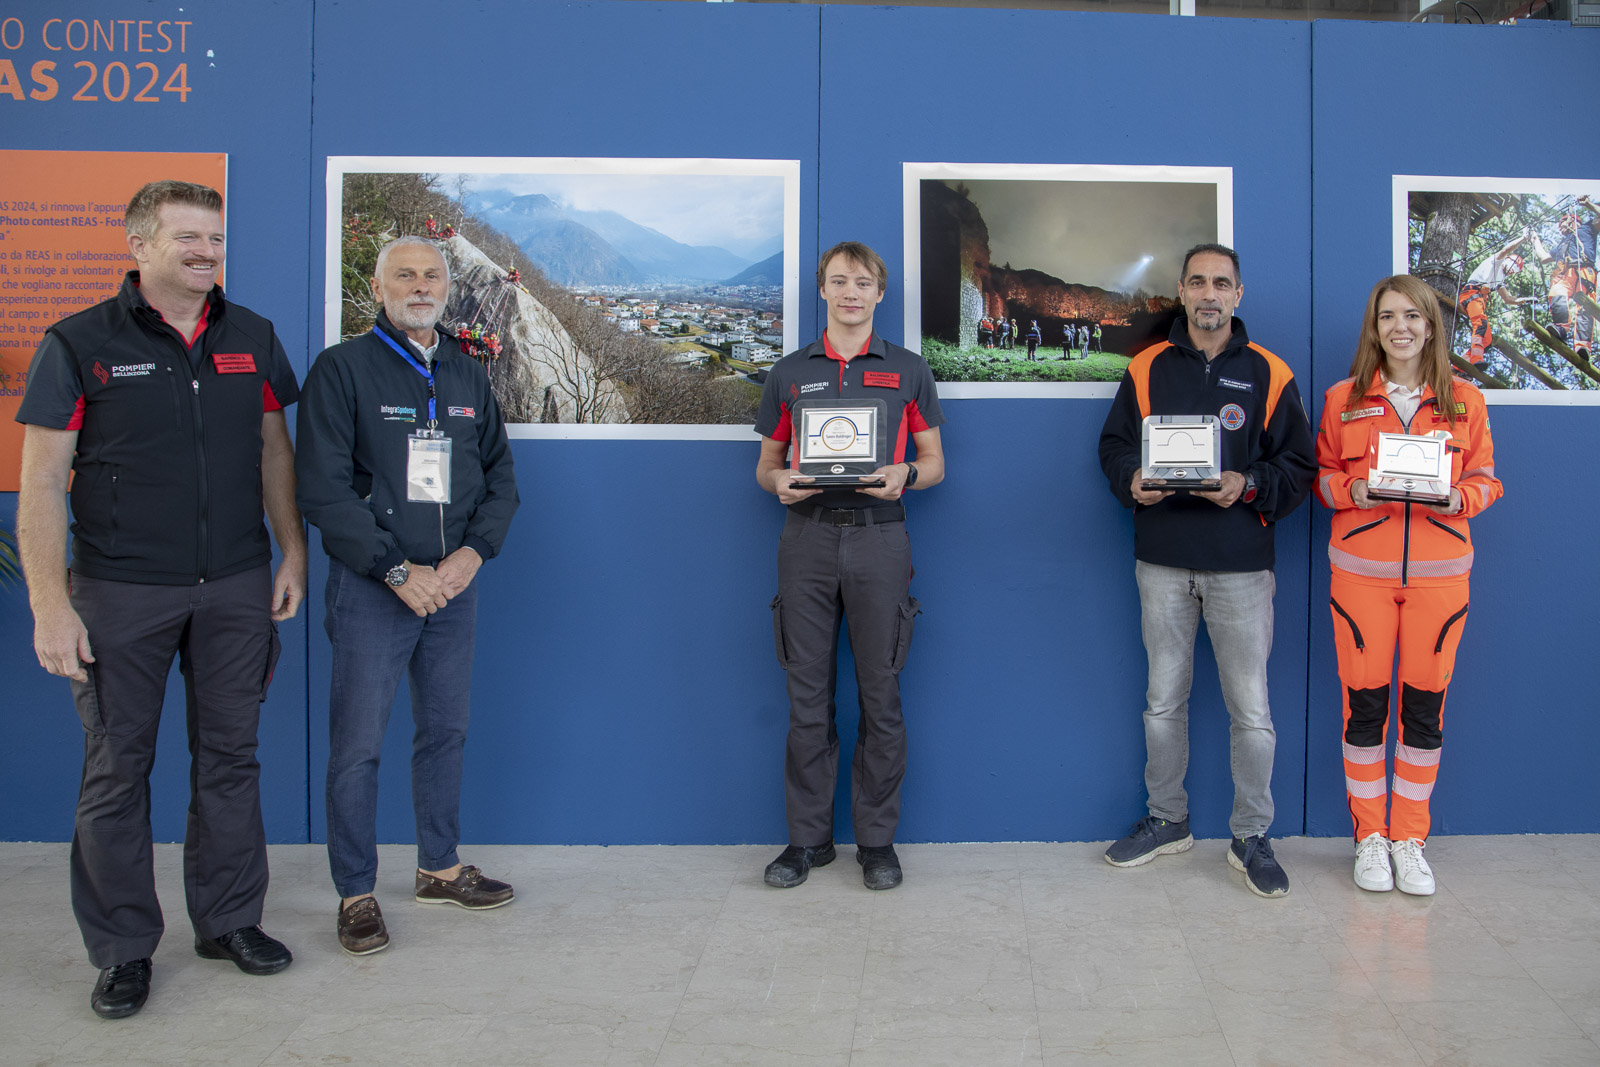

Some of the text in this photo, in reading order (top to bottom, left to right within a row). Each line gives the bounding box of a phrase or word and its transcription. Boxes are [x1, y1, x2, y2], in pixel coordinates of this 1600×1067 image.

[42, 18, 193, 53] CONTEST
[72, 60, 192, 102] 2024
[11, 201, 38, 212] 2024,
[40, 201, 48, 212] si
[50, 201, 86, 212] rinnova
[0, 215, 30, 226] Photo
[31, 217, 69, 227] contest
[71, 216, 98, 227] REAS
[10, 250, 22, 260] da
[25, 250, 50, 260] REAS
[53, 250, 63, 260] in
[65, 250, 133, 261] collaborazione
[13, 264, 21, 275] si
[24, 264, 56, 277] rivolge
[59, 264, 69, 275] ai
[72, 265, 114, 275] volontari
[117, 267, 124, 276] e
[1, 279, 19, 289] che
[21, 279, 62, 292] vogliano
[64, 281, 114, 290] raccontare
[50, 294, 97, 306] operativa.
[8, 310, 40, 321] campo
[42, 311, 49, 319] e
[52, 308, 56, 319] i
[17, 323, 27, 333] la
[22, 337, 31, 348] in
[111, 362, 155, 372] POMPIERI
[800, 381, 829, 390] POMPIERI
